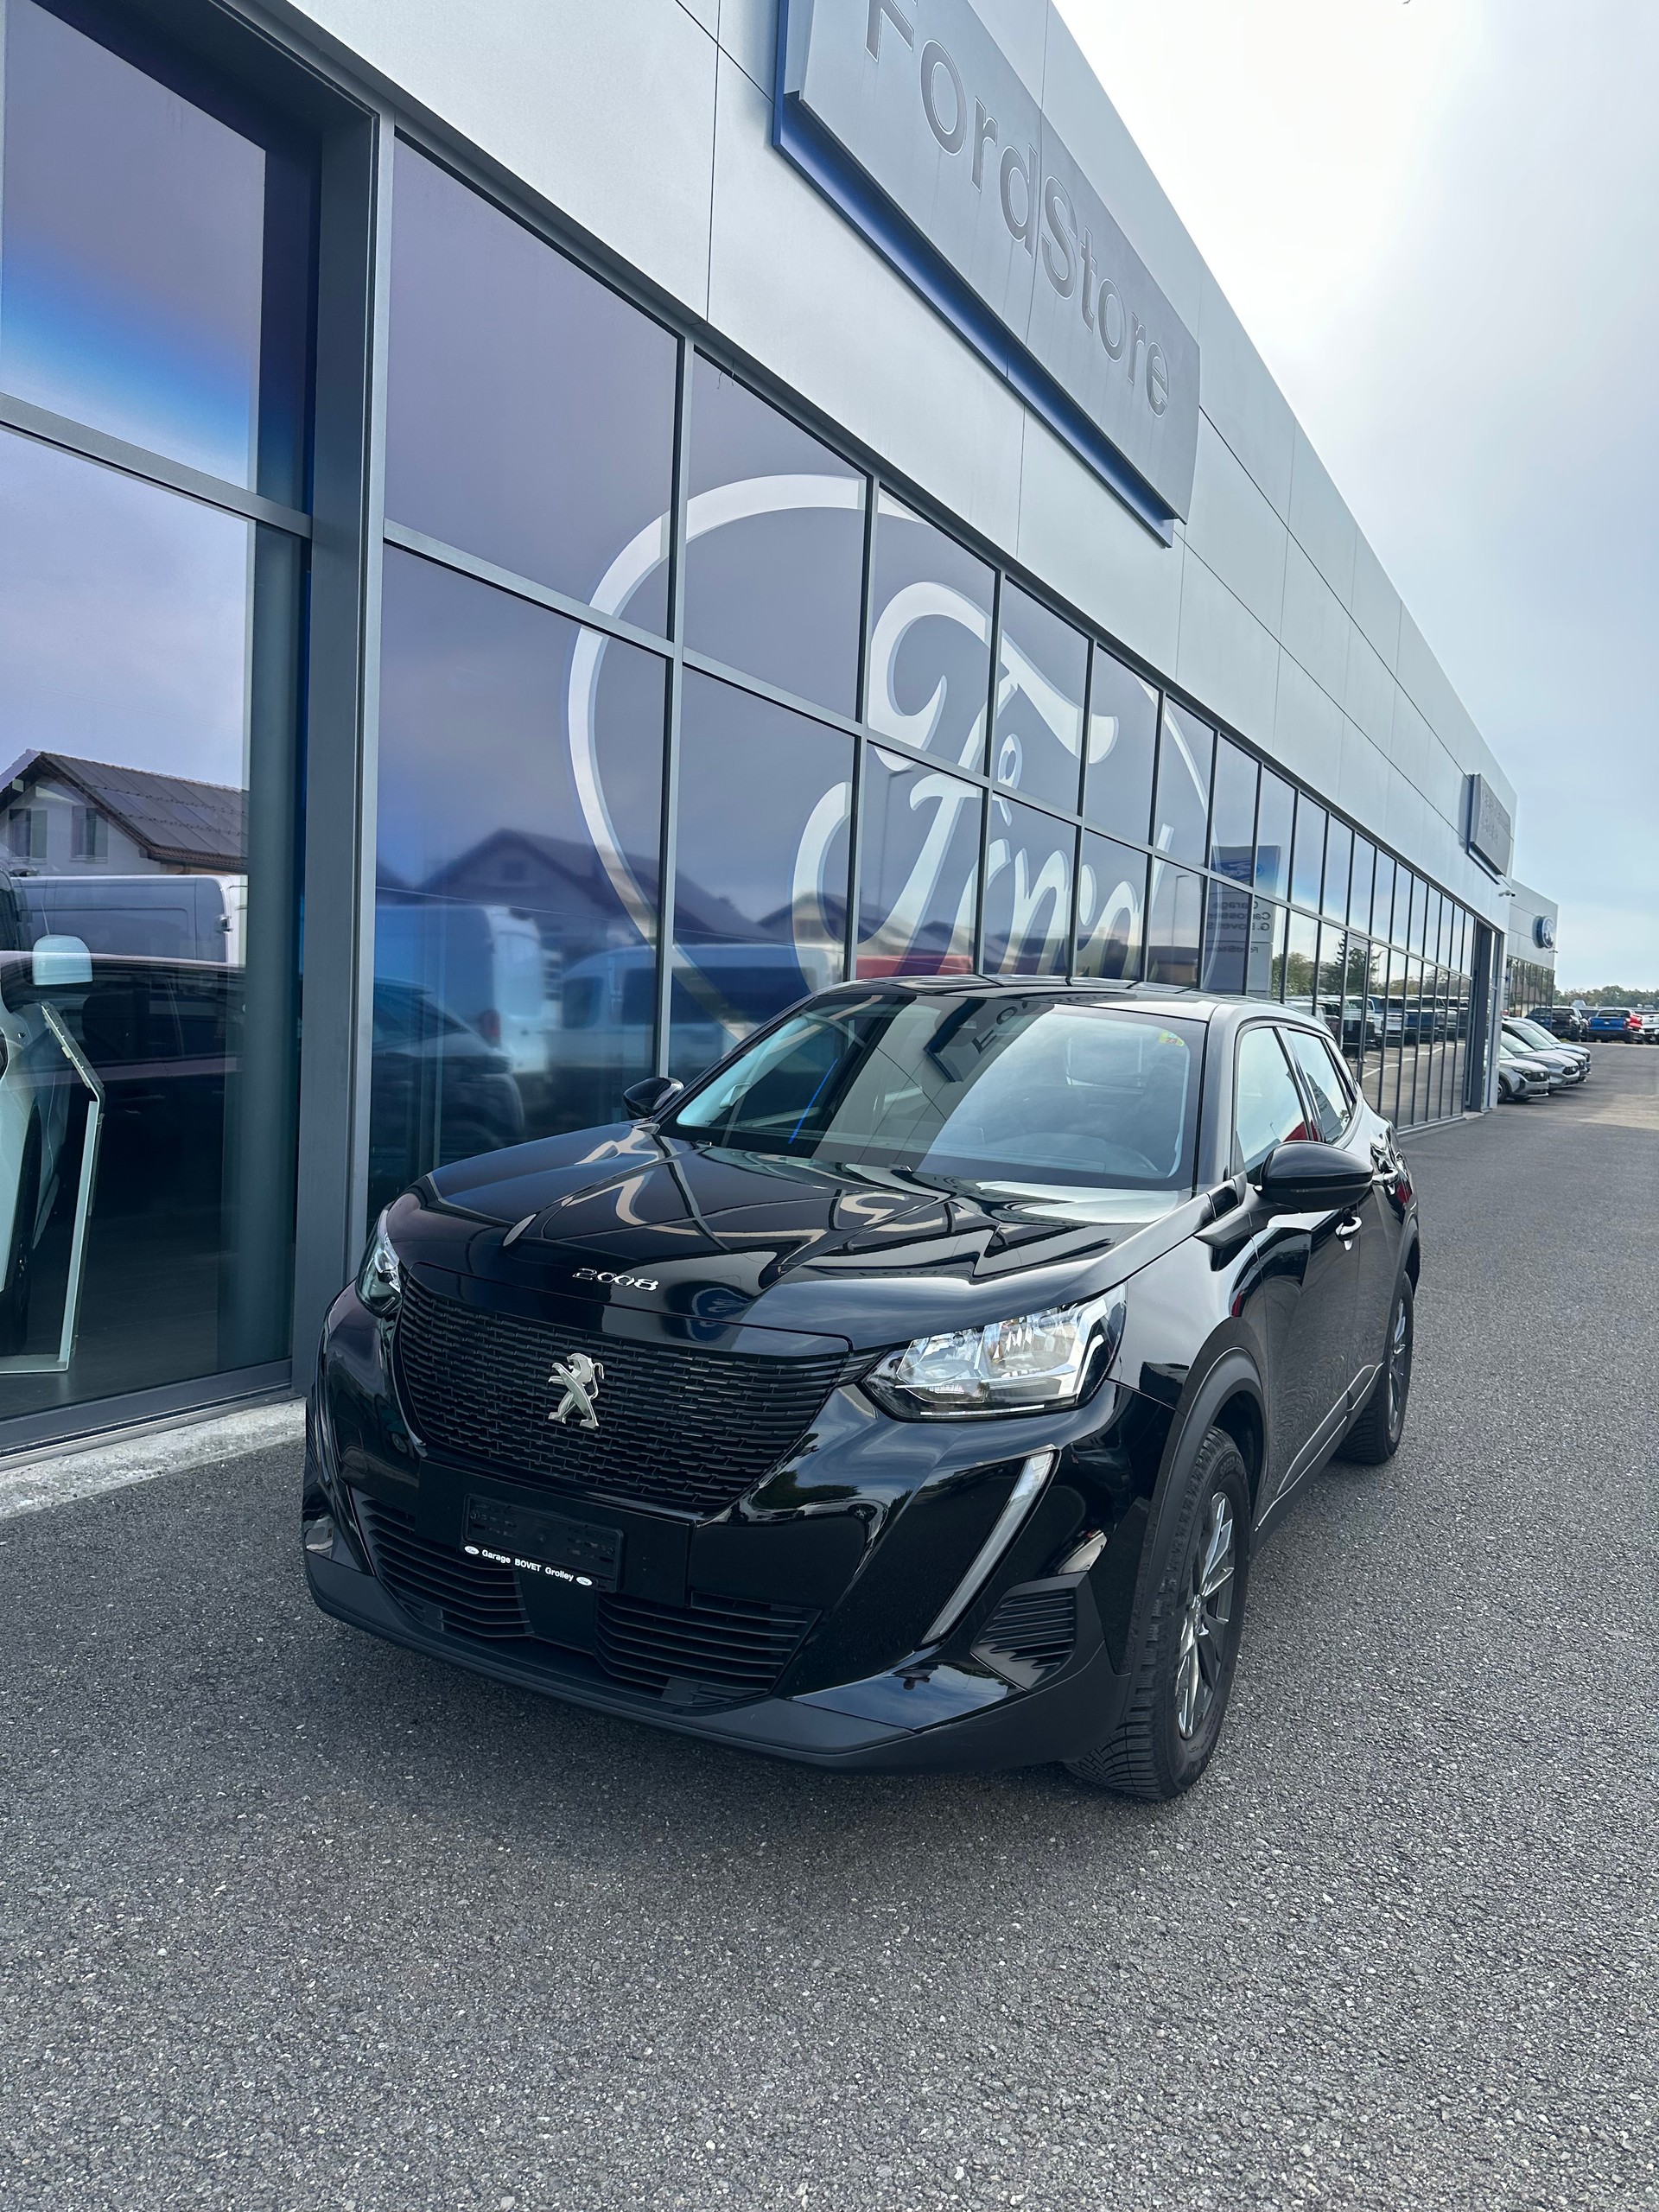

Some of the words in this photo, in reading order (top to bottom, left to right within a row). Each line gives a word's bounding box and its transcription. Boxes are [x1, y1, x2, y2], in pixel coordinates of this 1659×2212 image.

[791, 581, 1175, 995] Ford
[571, 1268, 659, 1291] 2008
[481, 1549, 512, 1564] Garage
[514, 1558, 543, 1573] BOVET
[544, 1567, 575, 1582] Grolley
